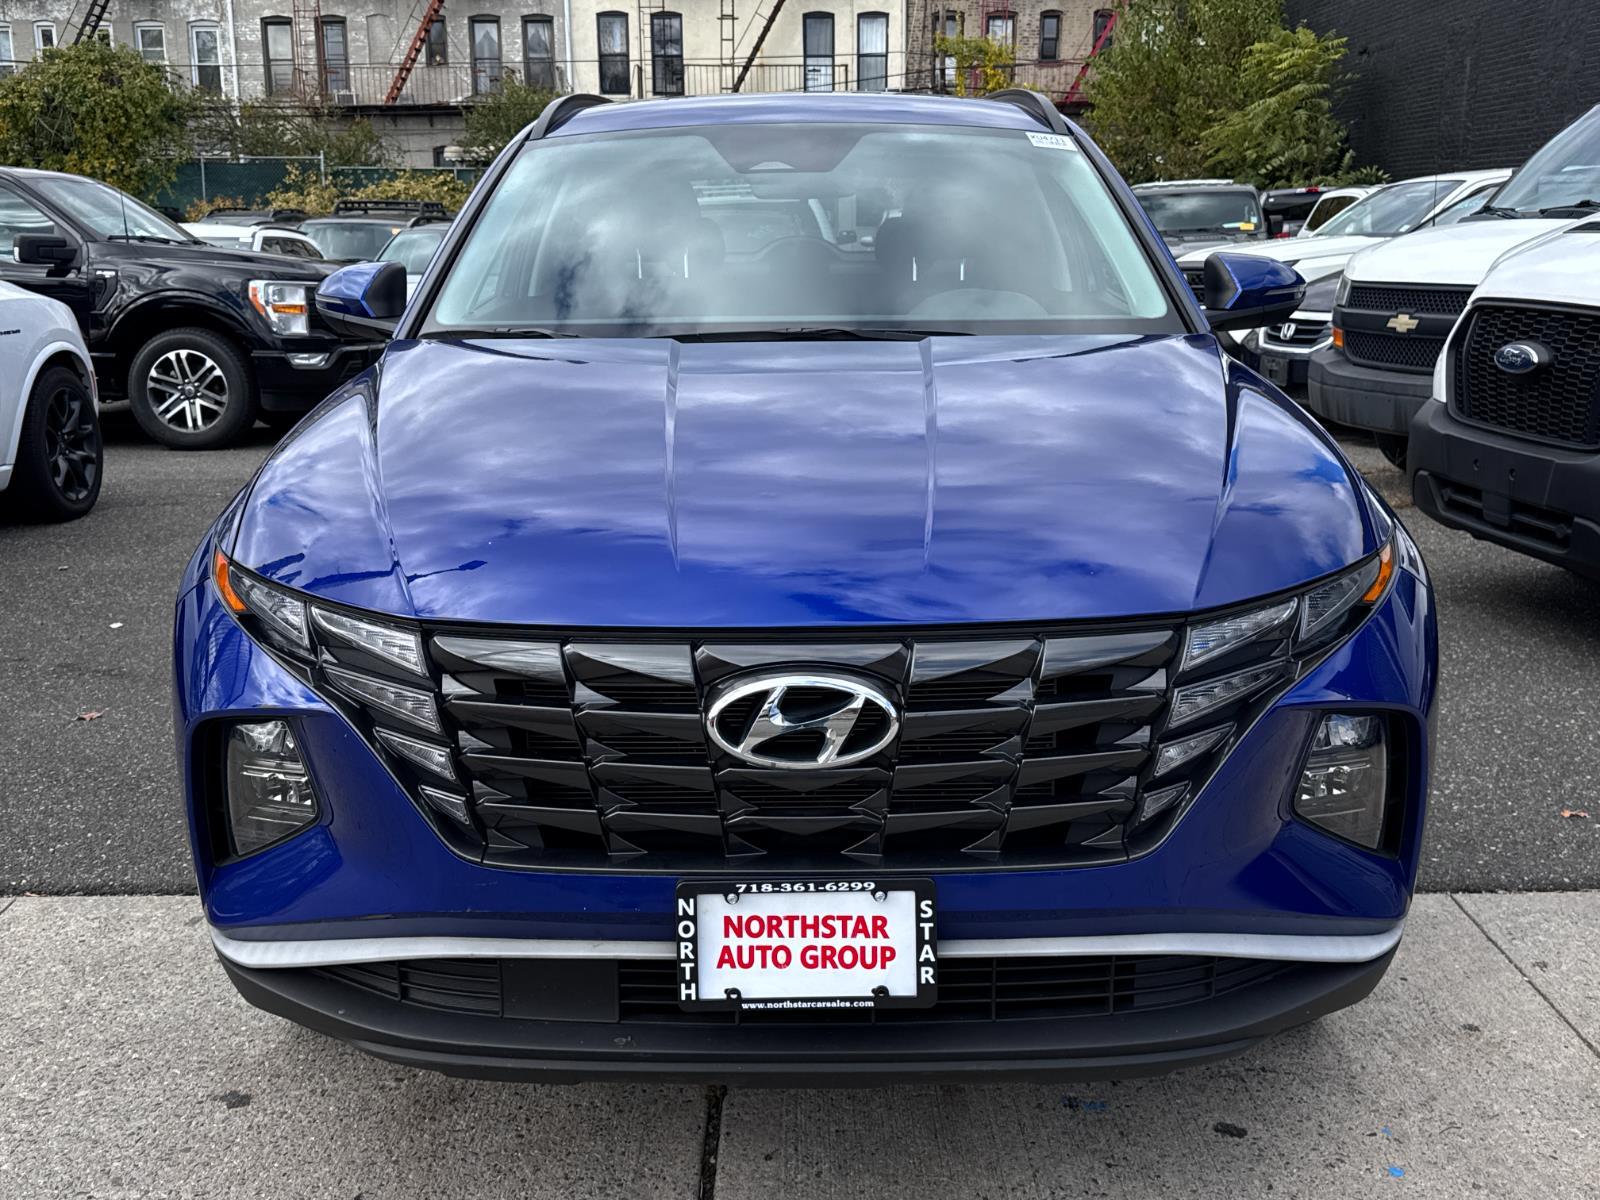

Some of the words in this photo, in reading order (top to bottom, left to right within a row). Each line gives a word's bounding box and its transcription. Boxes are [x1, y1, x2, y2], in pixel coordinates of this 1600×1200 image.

[735, 882, 876, 893] 718-361-6299
[723, 915, 890, 939] NORTHSTAR
[678, 898, 696, 1001] NORTH
[919, 900, 936, 984] STAR
[716, 945, 792, 969] AUTO
[800, 945, 896, 970] GROUP
[741, 1000, 875, 1010] www.northstarcarsales.com
